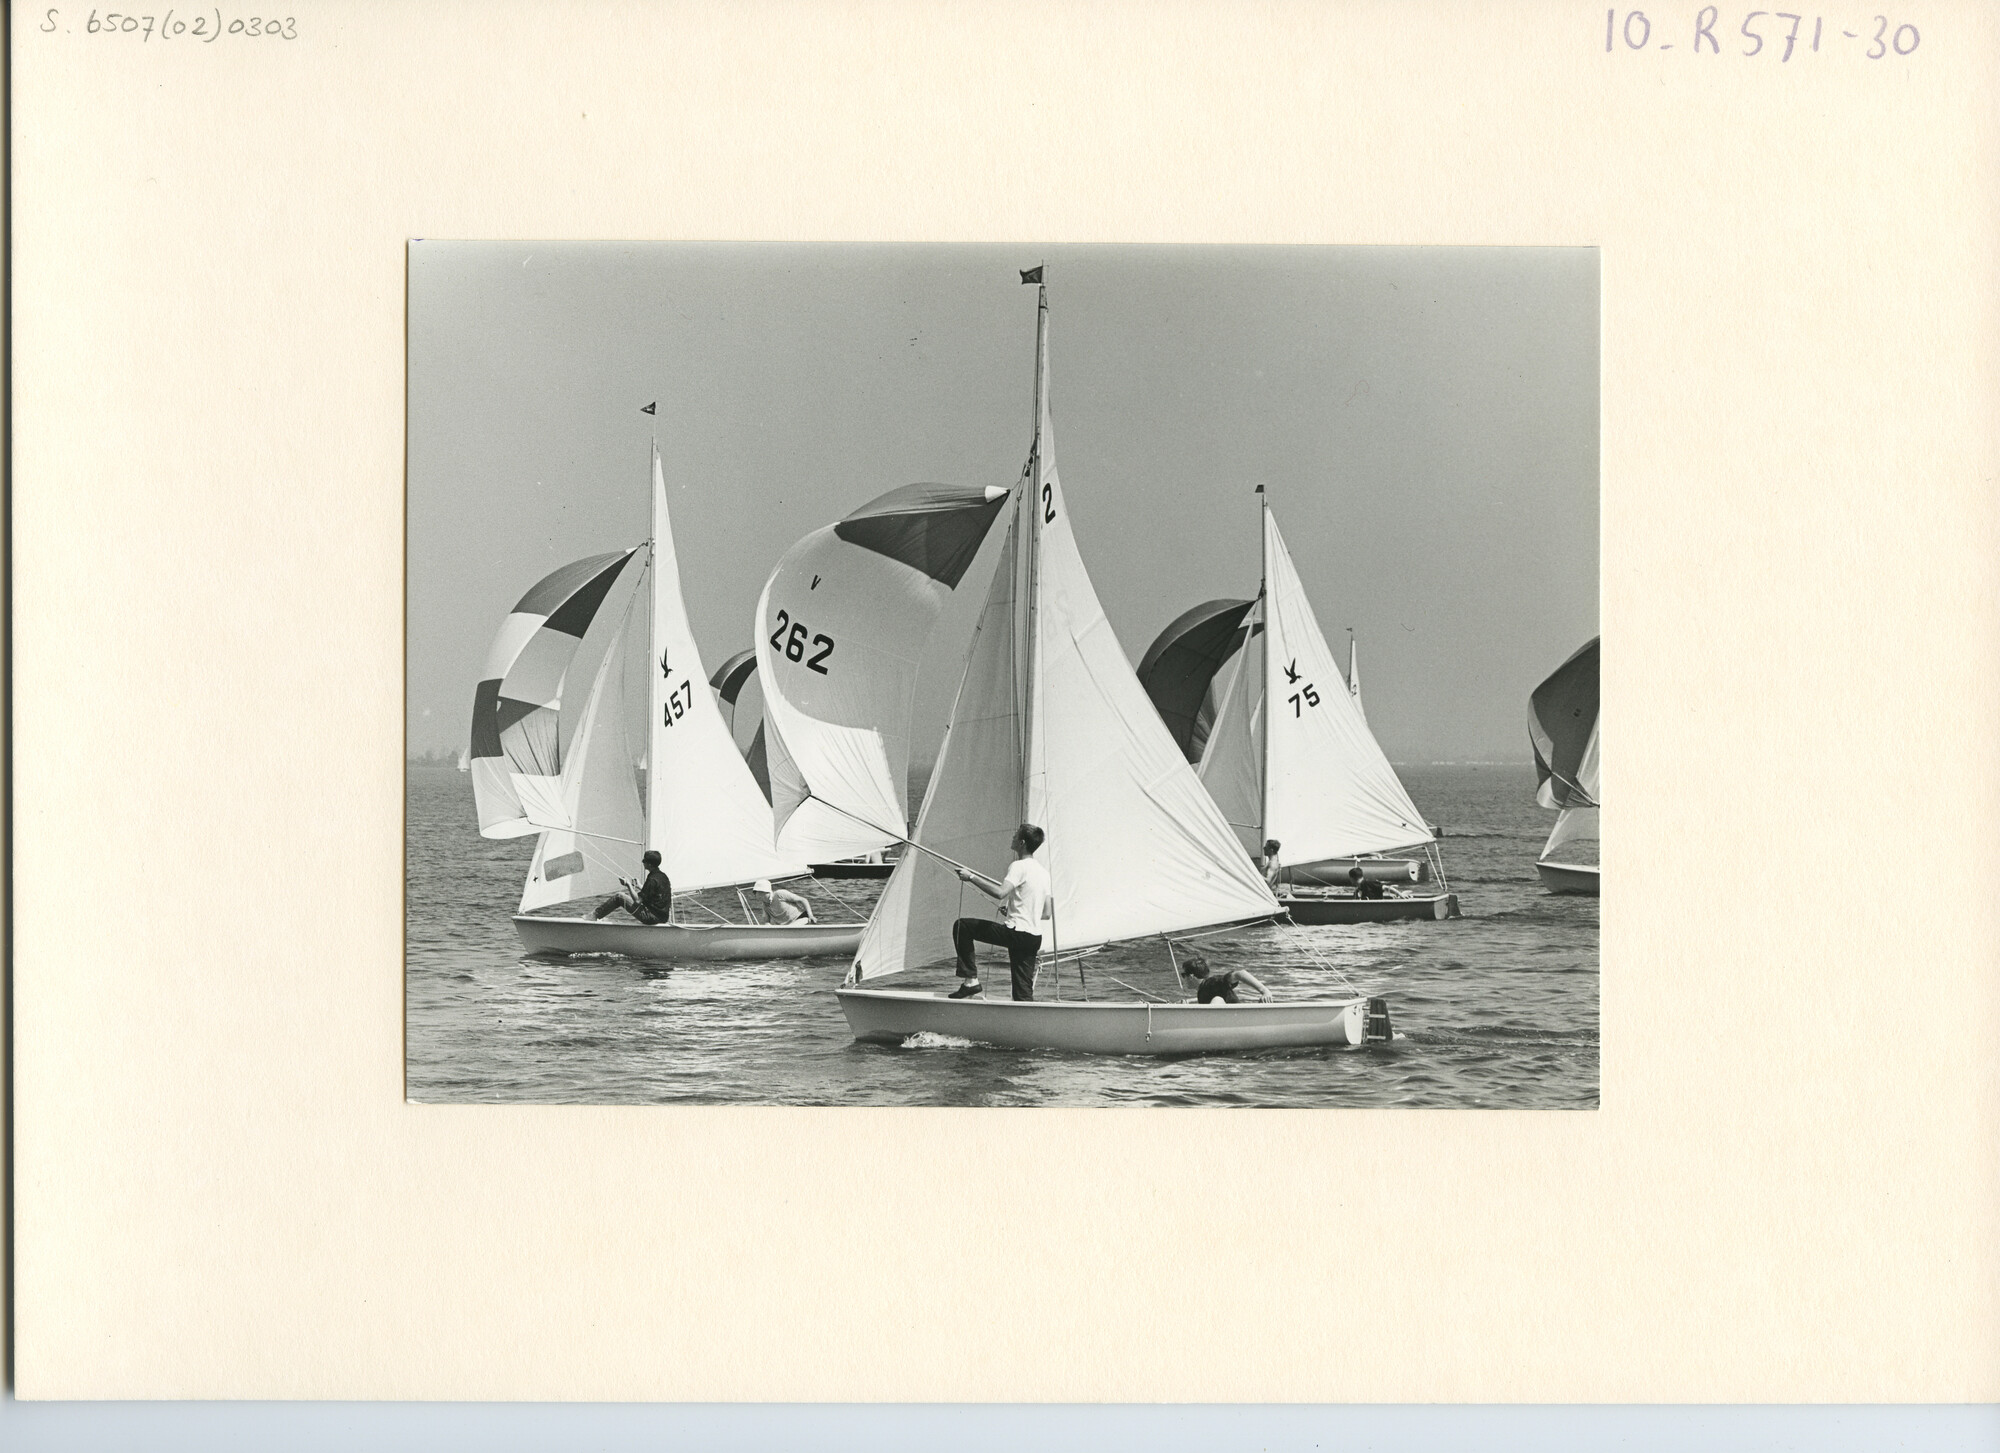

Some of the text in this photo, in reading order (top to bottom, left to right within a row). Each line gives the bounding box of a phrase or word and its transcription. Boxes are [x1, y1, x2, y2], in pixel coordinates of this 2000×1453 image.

[40, 7, 298, 43] S. 6507(02)0303
[1042, 482, 1056, 524] 2
[769, 609, 835, 676] 262
[663, 679, 692, 728] 457
[1288, 683, 1320, 719] 75
